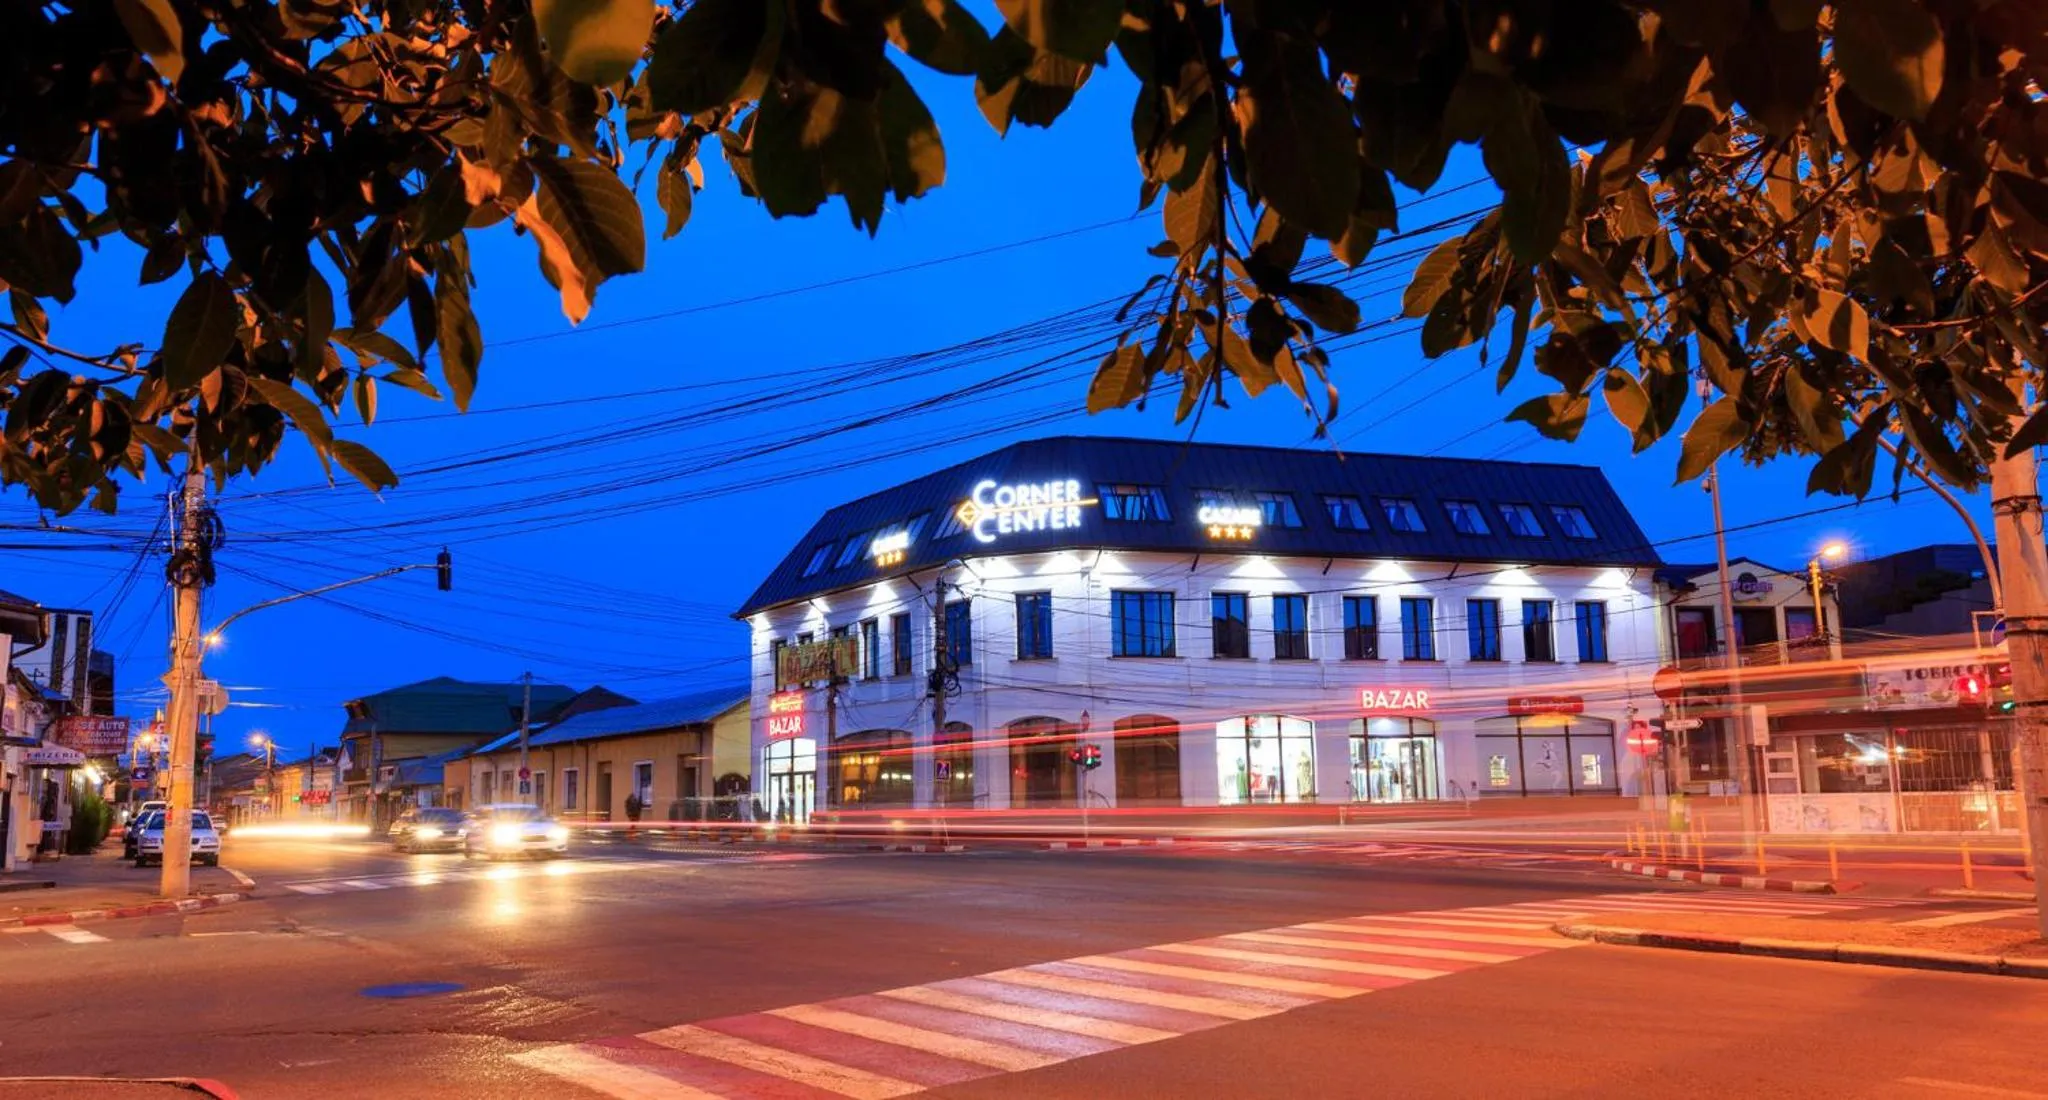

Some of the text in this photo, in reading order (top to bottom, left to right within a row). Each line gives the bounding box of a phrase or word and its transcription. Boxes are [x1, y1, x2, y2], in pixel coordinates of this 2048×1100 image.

[972, 478, 1081, 508] CORNER
[972, 506, 1082, 543] CENTER
[1361, 689, 1430, 709] BAZAR
[98, 720, 125, 730] AUTO
[769, 715, 801, 736] BAZAR
